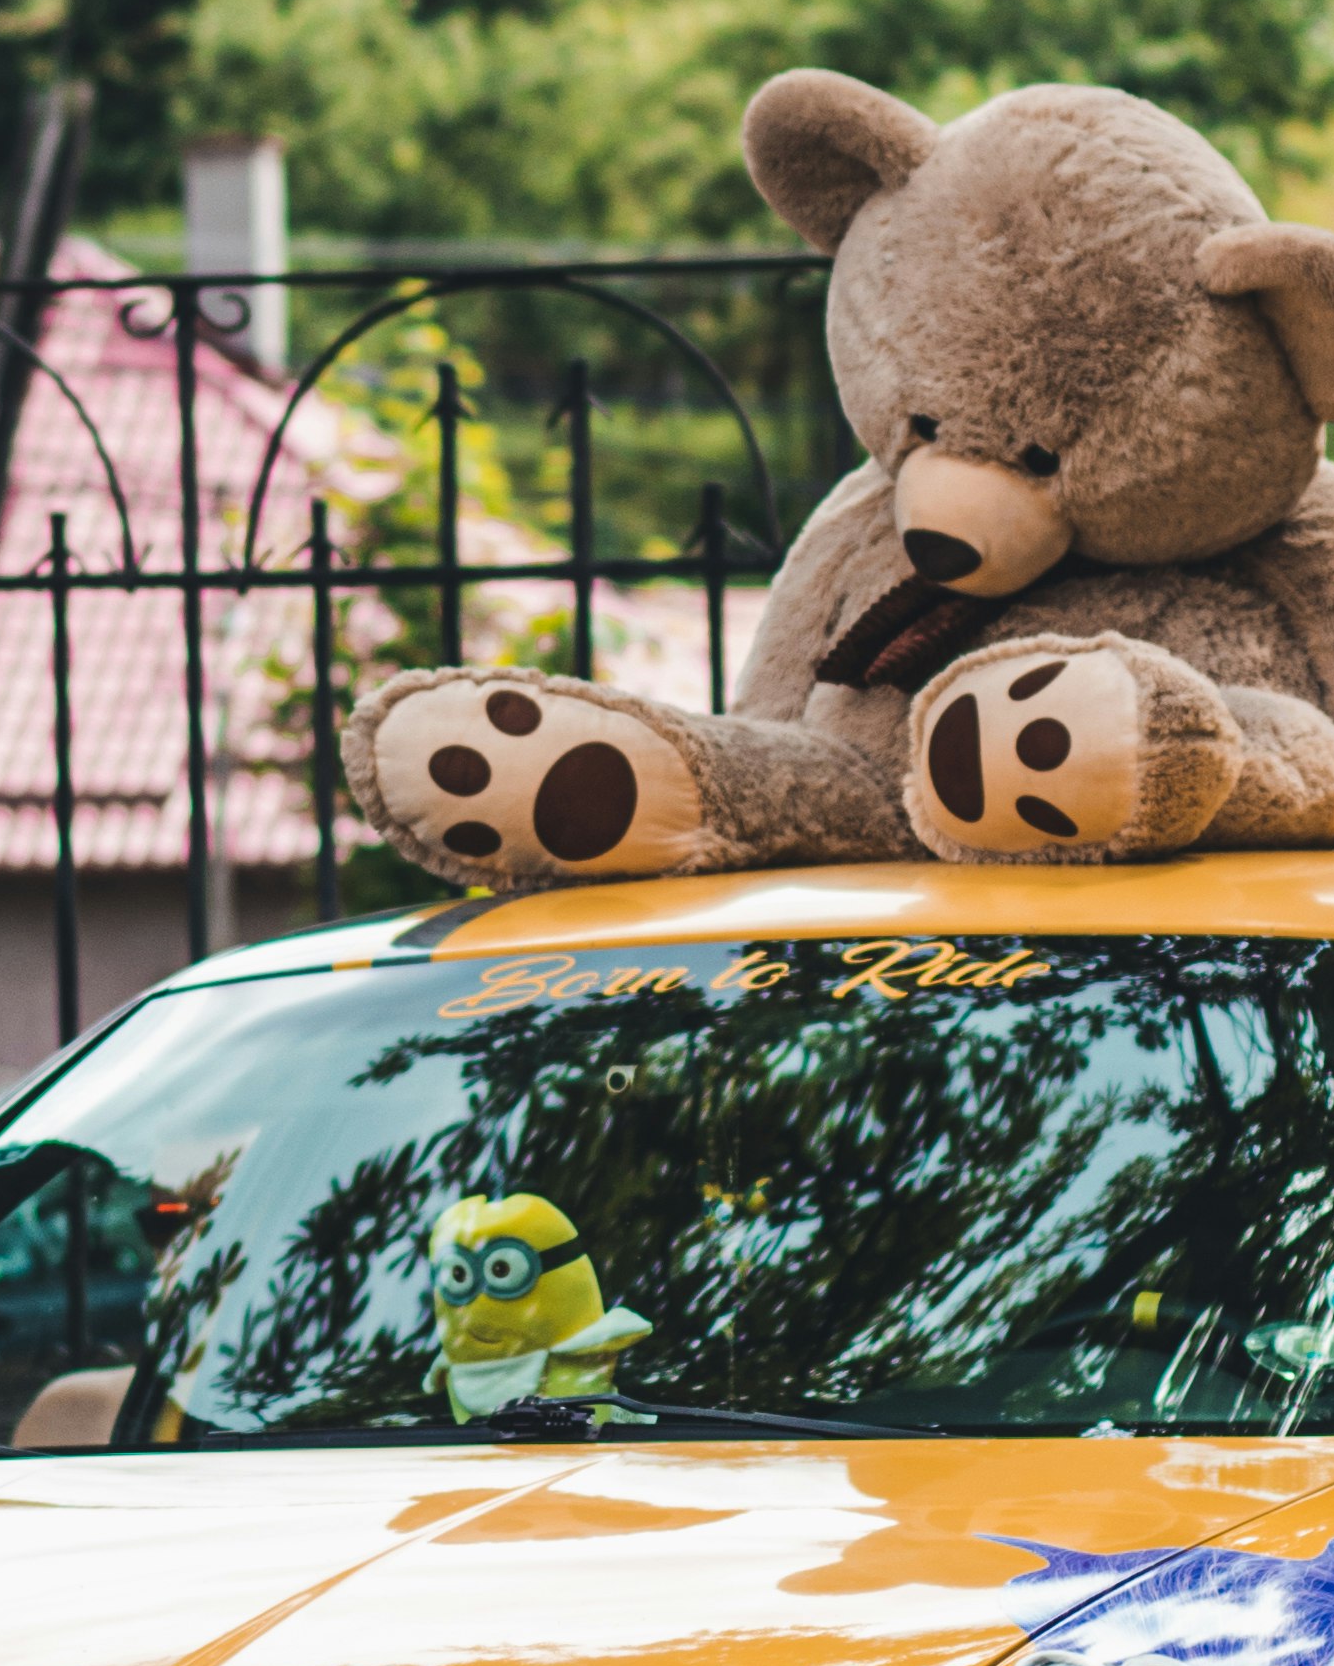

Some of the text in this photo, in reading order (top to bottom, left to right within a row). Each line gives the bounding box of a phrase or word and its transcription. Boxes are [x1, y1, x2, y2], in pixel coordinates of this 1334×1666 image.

[438, 940, 1052, 1019] Born to Ride
